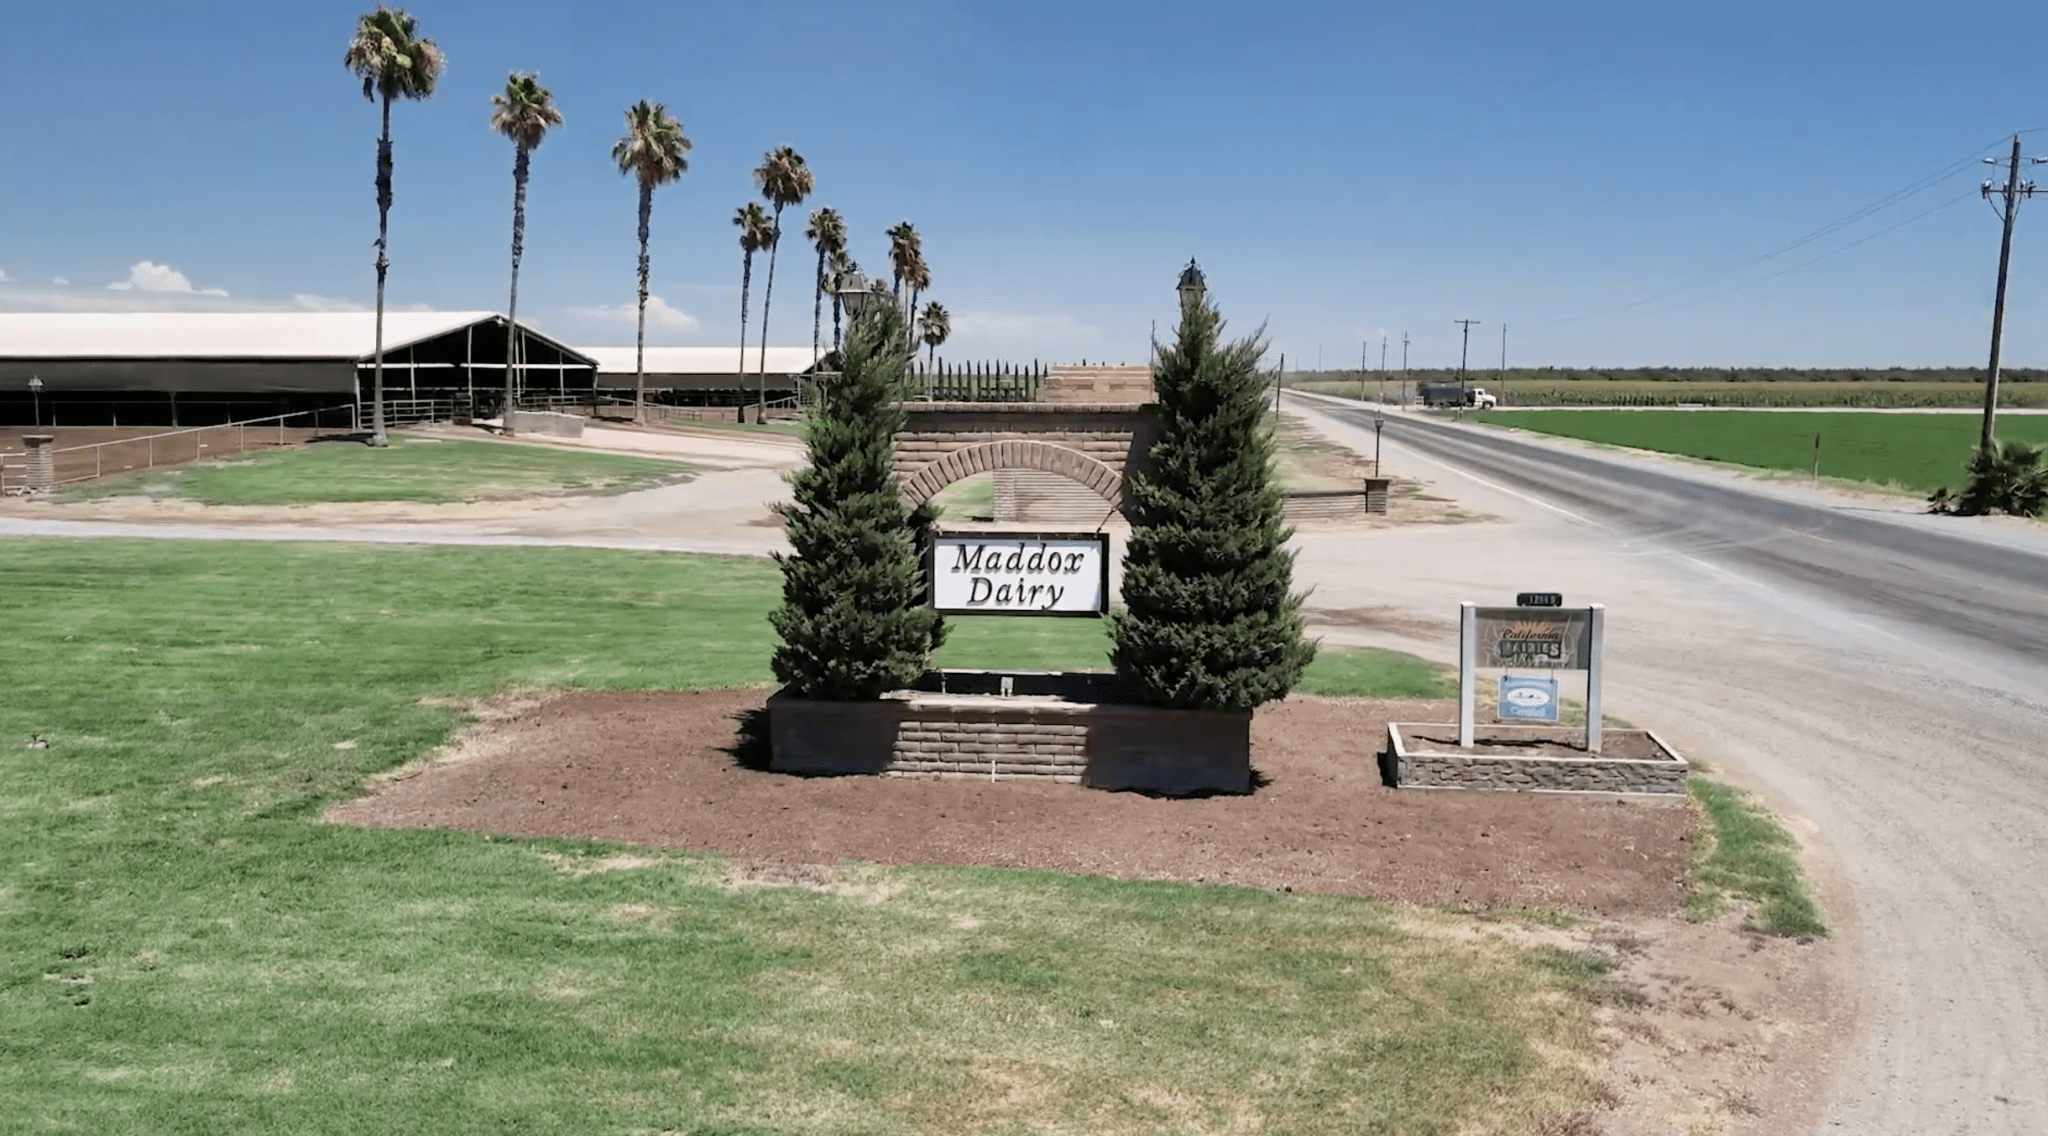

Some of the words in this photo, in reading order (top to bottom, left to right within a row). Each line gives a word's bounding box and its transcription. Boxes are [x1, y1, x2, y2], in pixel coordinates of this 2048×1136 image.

[952, 542, 1084, 573] Maddox
[967, 577, 1064, 610] Dairy
[1503, 628, 1559, 640] California
